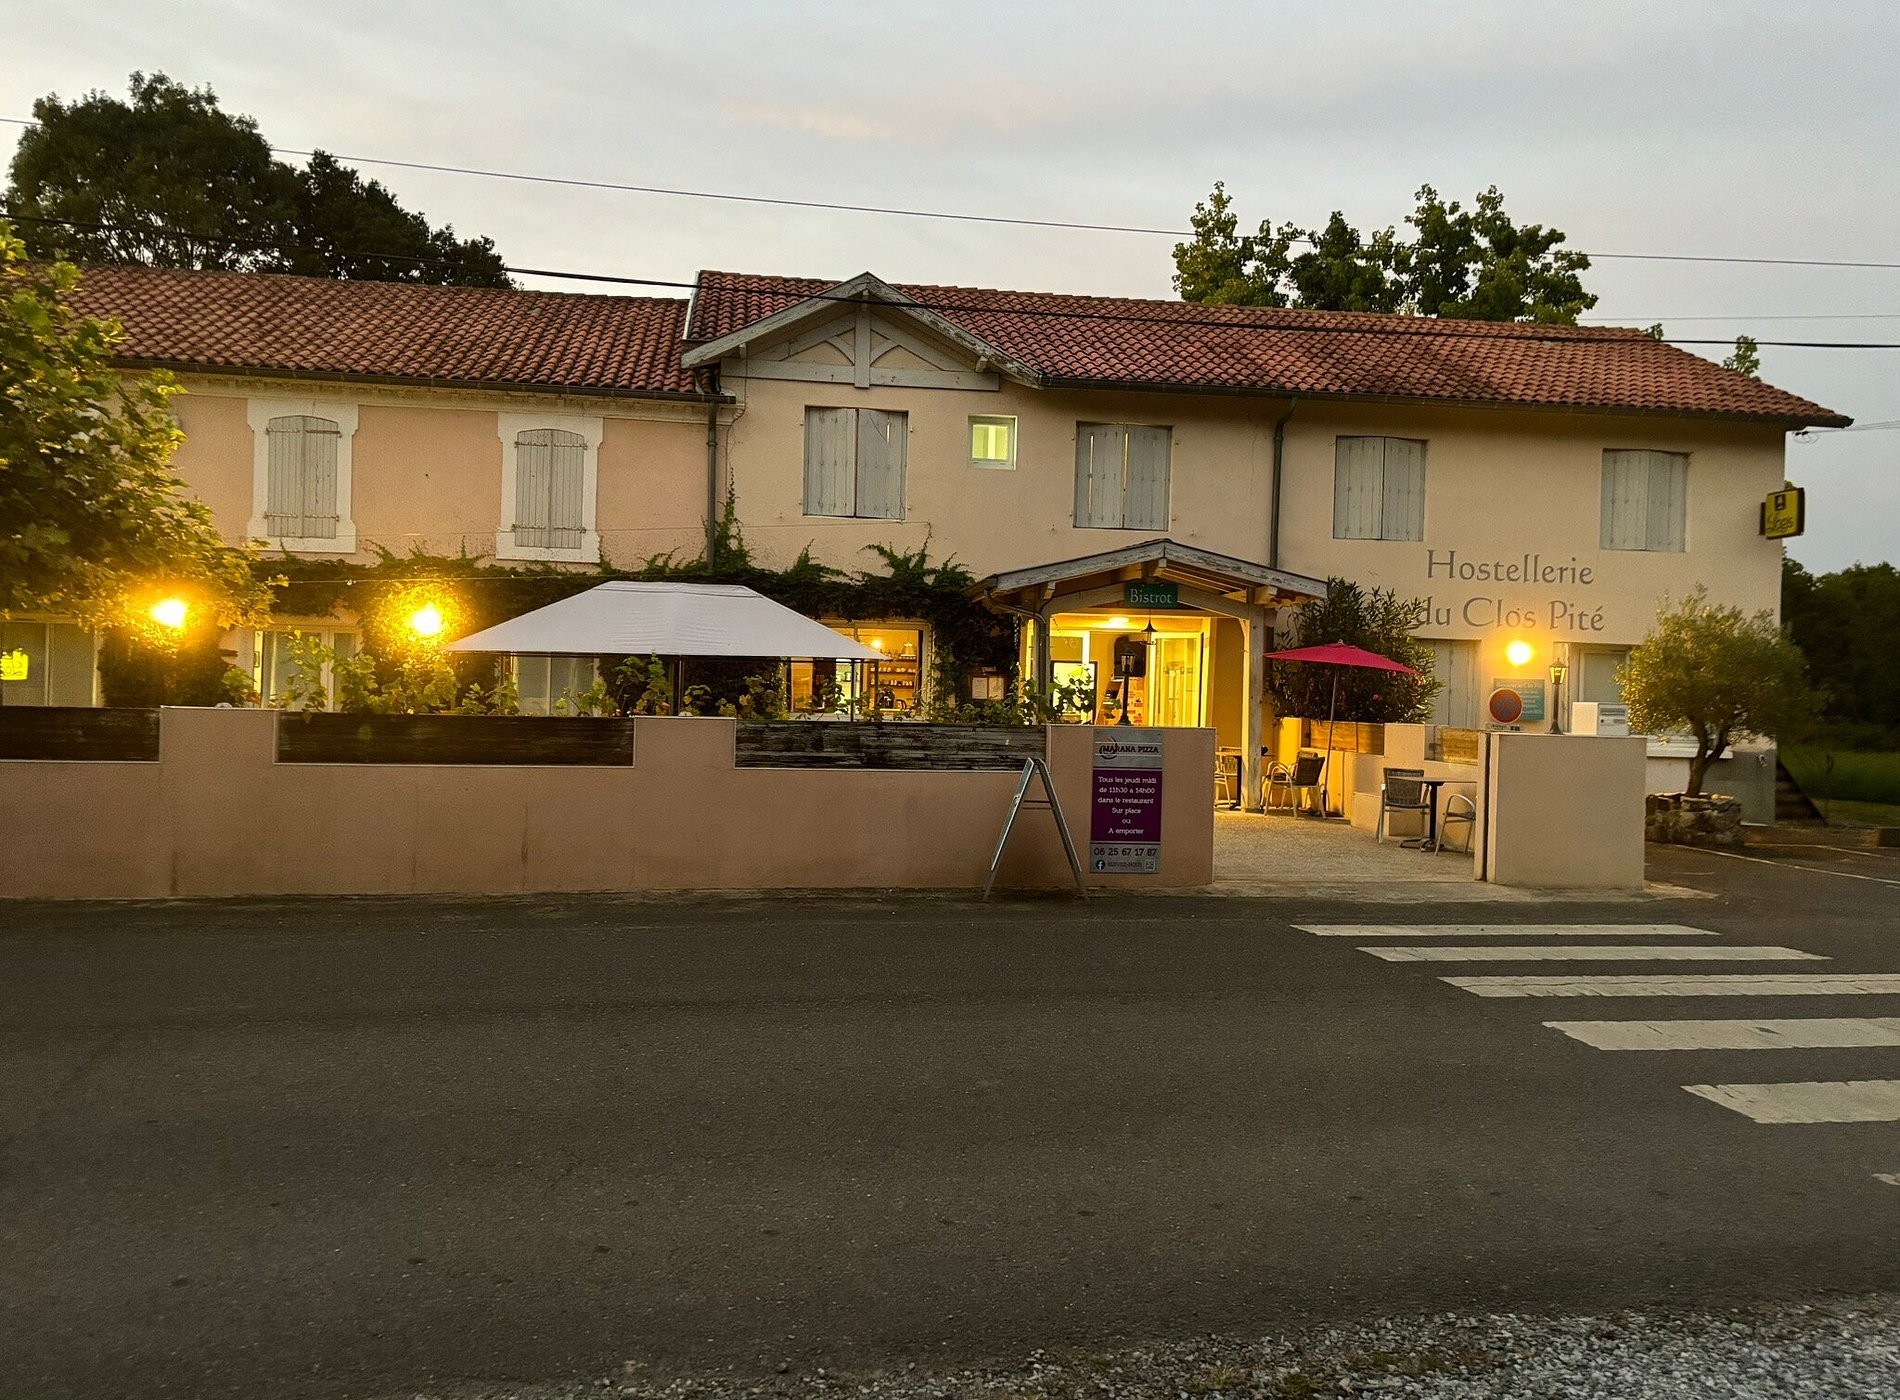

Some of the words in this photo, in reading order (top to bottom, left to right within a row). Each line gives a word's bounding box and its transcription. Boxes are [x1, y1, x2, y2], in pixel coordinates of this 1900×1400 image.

[1427, 549, 1594, 585] Hostellerie
[1130, 588, 1172, 604] Bistrot
[1415, 596, 1451, 626] du
[1463, 597, 1537, 629] Clos
[1548, 601, 1605, 632] Pité
[1124, 777, 1141, 785] jeudi
[1124, 807, 1142, 815] place
[1094, 848, 1105, 856] 06
[1108, 848, 1119, 856] 25
[1122, 848, 1132, 856] 67
[1135, 848, 1145, 856] 17
[1147, 848, 1157, 857] 87
